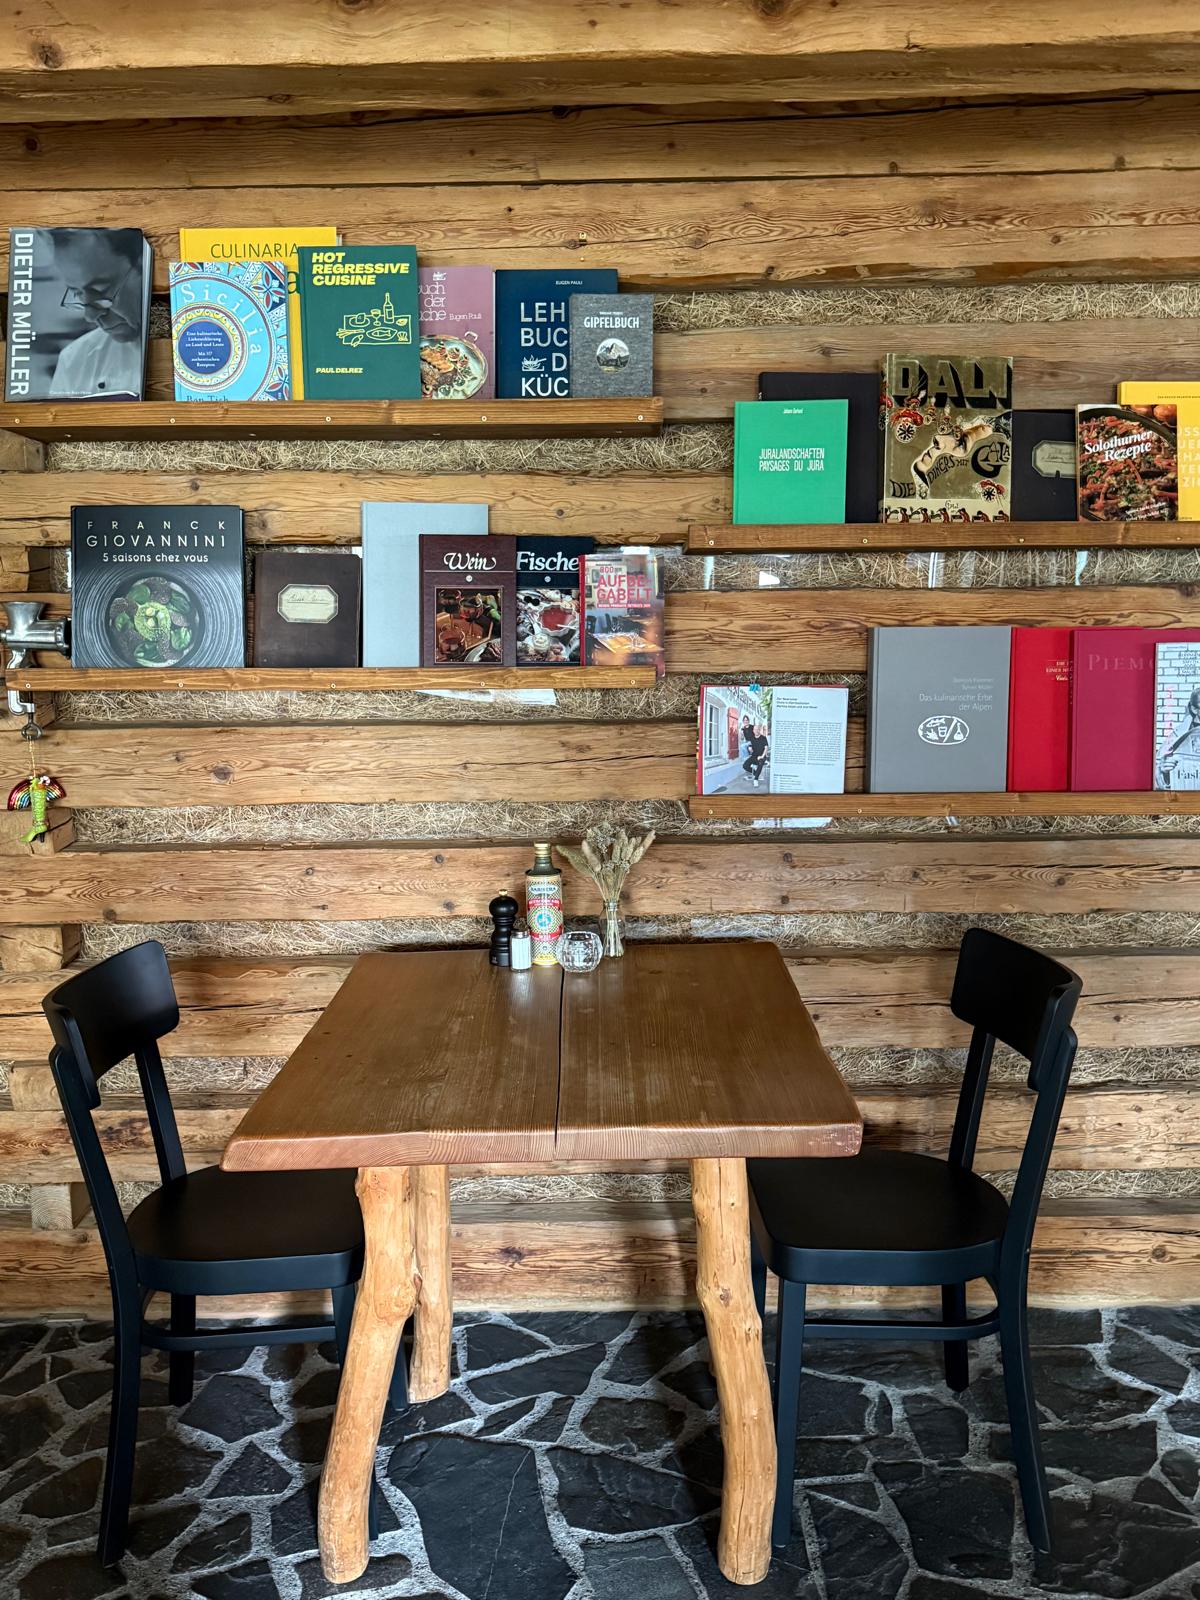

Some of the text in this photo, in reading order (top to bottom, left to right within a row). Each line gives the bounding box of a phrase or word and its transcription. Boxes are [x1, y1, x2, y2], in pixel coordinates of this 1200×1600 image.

[210, 243, 299, 258] CULINARIA
[311, 252, 346, 263] HOT
[312, 263, 410, 274] REGRESSIVE
[312, 275, 377, 286] CUISINE
[418, 281, 446, 295] uch
[424, 295, 446, 308] der
[10, 233, 36, 395] DIETER MÜLLER
[181, 283, 263, 354] Sicilia
[520, 302, 565, 322] LEH
[583, 316, 640, 328] GIPFELBUCH
[520, 327, 568, 347] BUC
[521, 374, 569, 396] KÜC
[1084, 430, 1153, 454] Solothurner
[759, 448, 825, 460] JURALANDSCHAFTEN
[1101, 442, 1152, 462] Rezepte
[759, 460, 825, 471] PAYSAGES DU JURA
[890, 480, 916, 498] DIE
[87, 521, 225, 530] FRANCK
[86, 535, 225, 547] GIOVANNINI
[102, 553, 209, 562] 5 saisons chez vous
[443, 552, 497, 570] Wein
[516, 551, 579, 571] Fische
[1088, 654, 1153, 671] PIEM
[920, 693, 933, 701] Das
[934, 693, 976, 701] kulinarische
[959, 703, 993, 712] der Alpen
